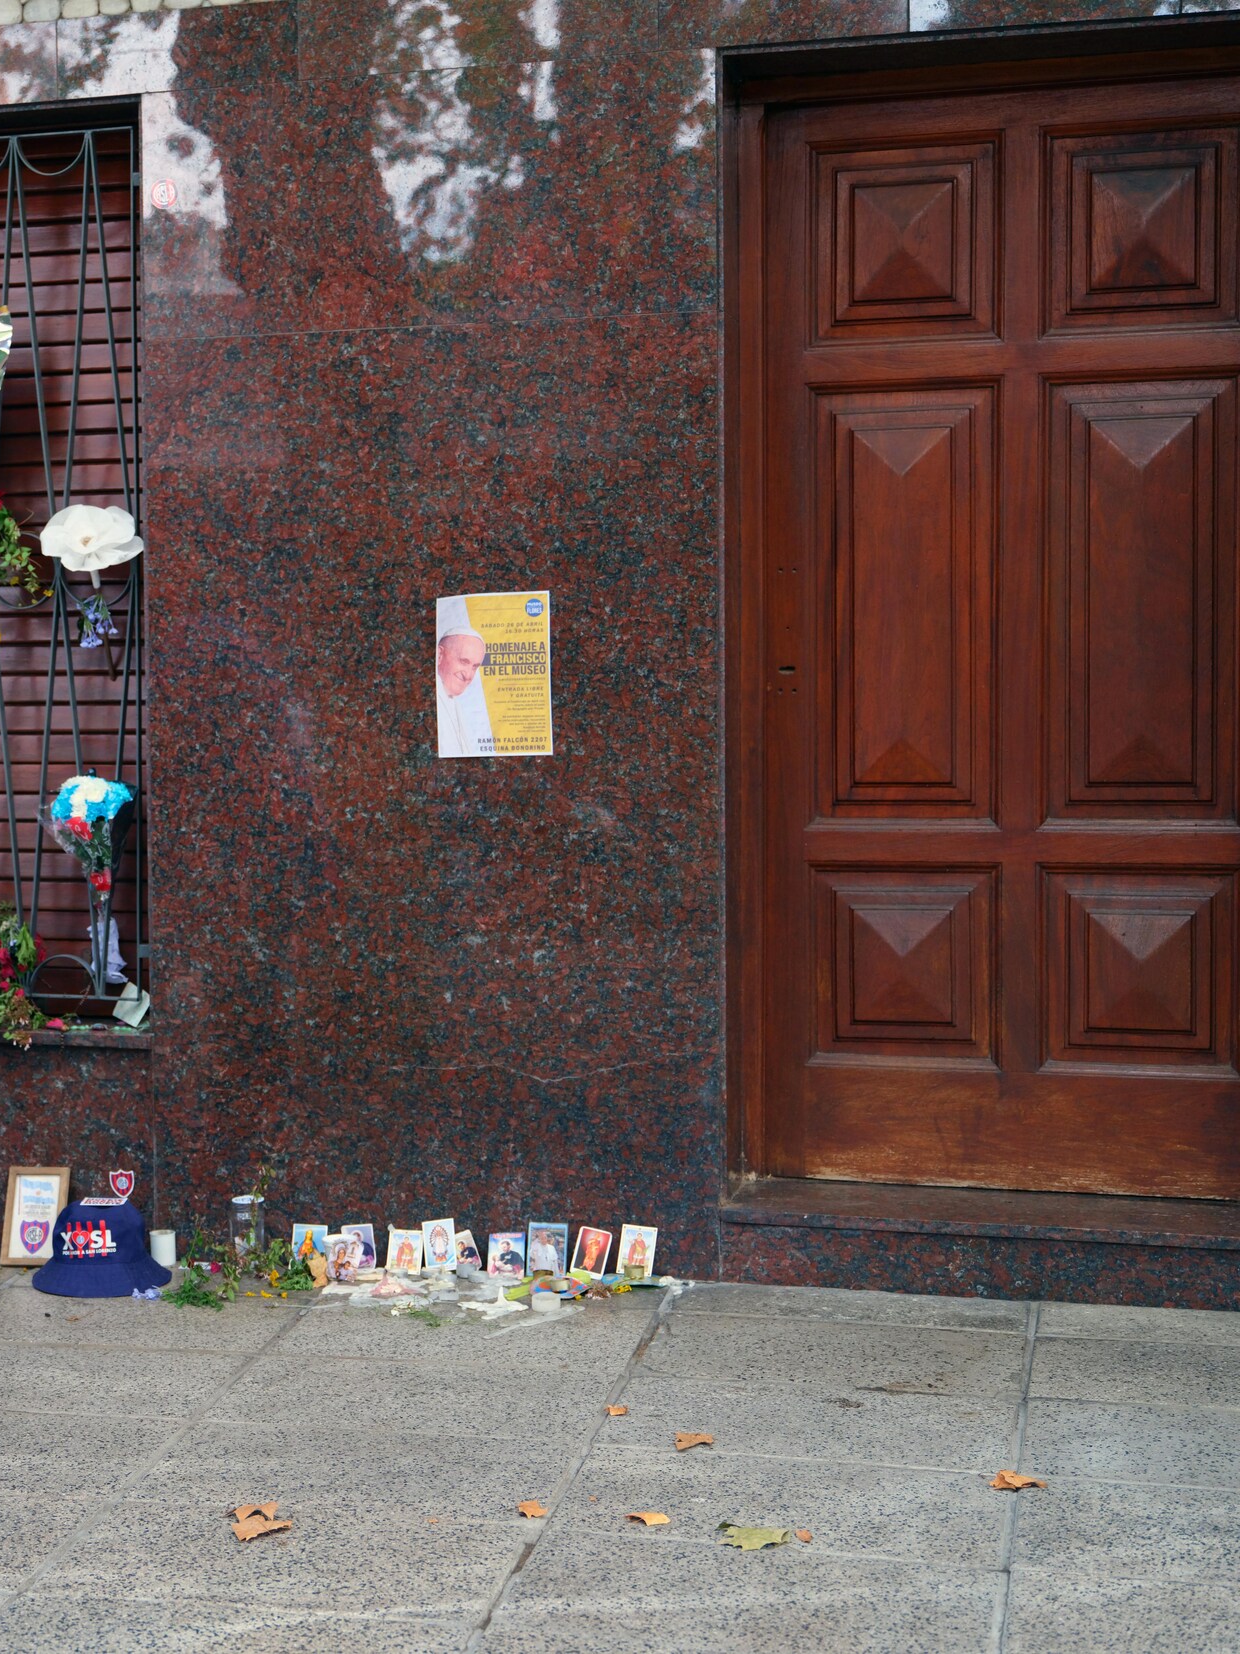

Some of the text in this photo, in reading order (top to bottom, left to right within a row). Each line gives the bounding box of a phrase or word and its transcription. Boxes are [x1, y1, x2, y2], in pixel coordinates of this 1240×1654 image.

[485, 641, 545, 653] HOMENAJE A
[490, 653, 546, 664] FRANCISCO
[483, 665, 546, 676] EN EL MUSEO
[477, 736, 501, 744] RAMÓN
